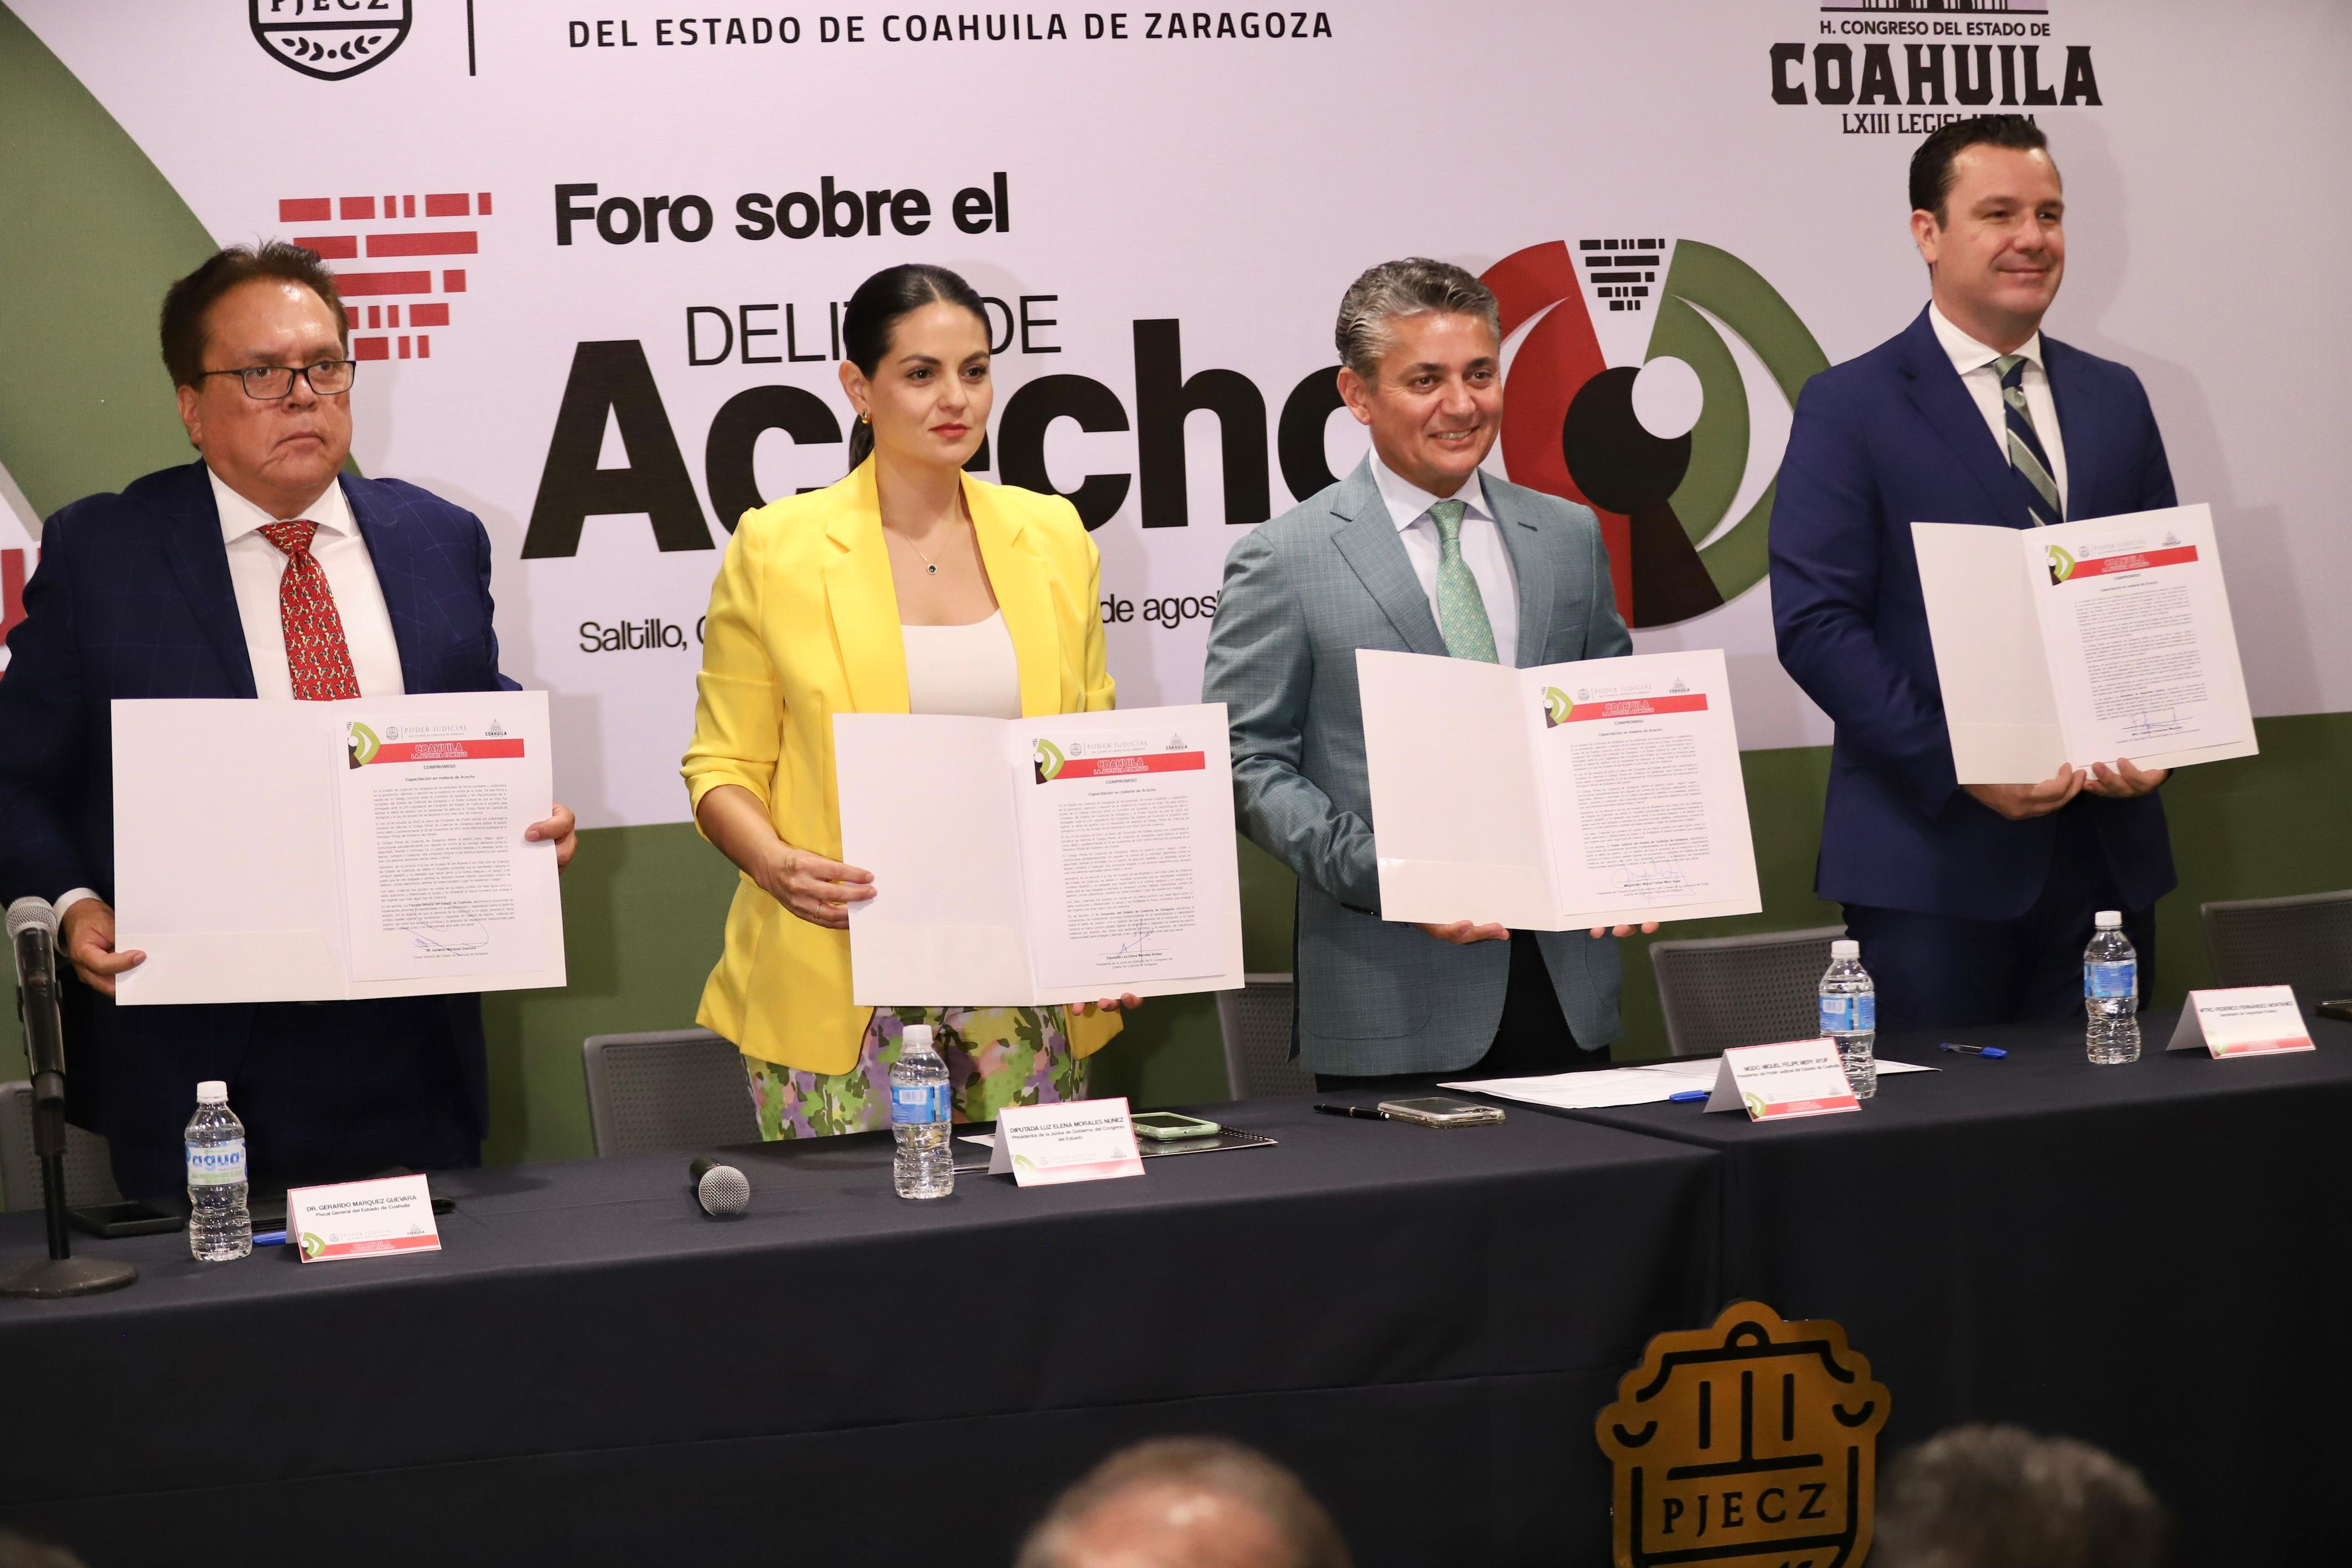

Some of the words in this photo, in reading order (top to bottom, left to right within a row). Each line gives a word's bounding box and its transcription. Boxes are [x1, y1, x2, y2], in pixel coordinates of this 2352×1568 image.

[569, 20, 637, 47] DEL
[656, 17, 799, 45] ESTADO
[820, 16, 864, 42] DE
[883, 14, 1066, 41] COAHUILA
[1085, 14, 1127, 39] DE
[1145, 12, 1332, 38] ZARAGOZA
[1820, 21, 1836, 34] H.
[1840, 21, 1929, 36] CONGRESO
[1933, 22, 1962, 36] DEL
[1966, 22, 2026, 37] ESTADO
[2030, 23, 2051, 36] DE
[1769, 42, 2103, 106] COAHUILA
[1842, 114, 1890, 134] LXIII
[555, 183, 713, 245] Foro
[736, 176, 931, 240] sobre
[953, 172, 1009, 234] el
[686, 301, 849, 366] DELI
[521, 319, 1352, 560] Acch
[1100, 594, 1134, 623] de
[1143, 590, 1220, 629] agos
[580, 618, 687, 653] Saltillo,
[415, 743, 463, 753] COAHUILA
[1097, 757, 1144, 769] COAHUILA
[319, 1202, 351, 1211] GERARDO
[1662, 1483, 1827, 1537] PJECZ
